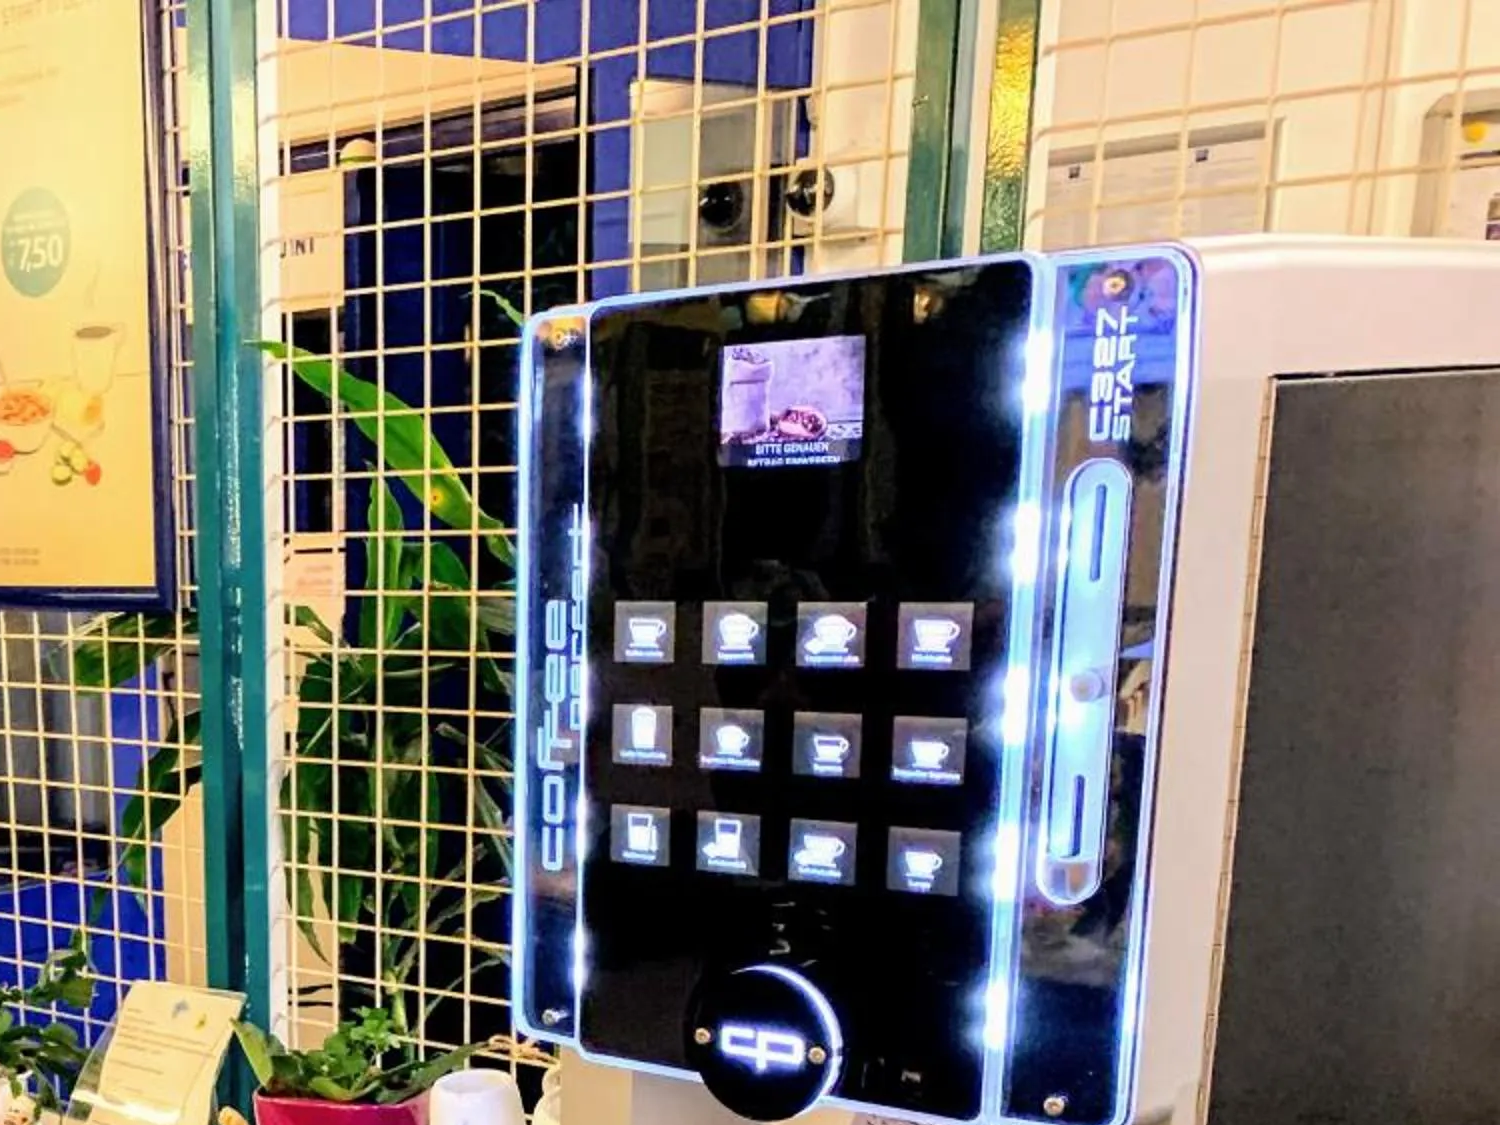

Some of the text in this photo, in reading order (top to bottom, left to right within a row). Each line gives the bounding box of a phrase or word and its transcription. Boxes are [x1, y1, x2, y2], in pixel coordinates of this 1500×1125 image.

[18, 233, 63, 273] 7,50
[1089, 307, 1118, 441] C327
[1112, 305, 1139, 442] START
[755, 442, 782, 456] BITTE
[537, 600, 572, 872] coffee
